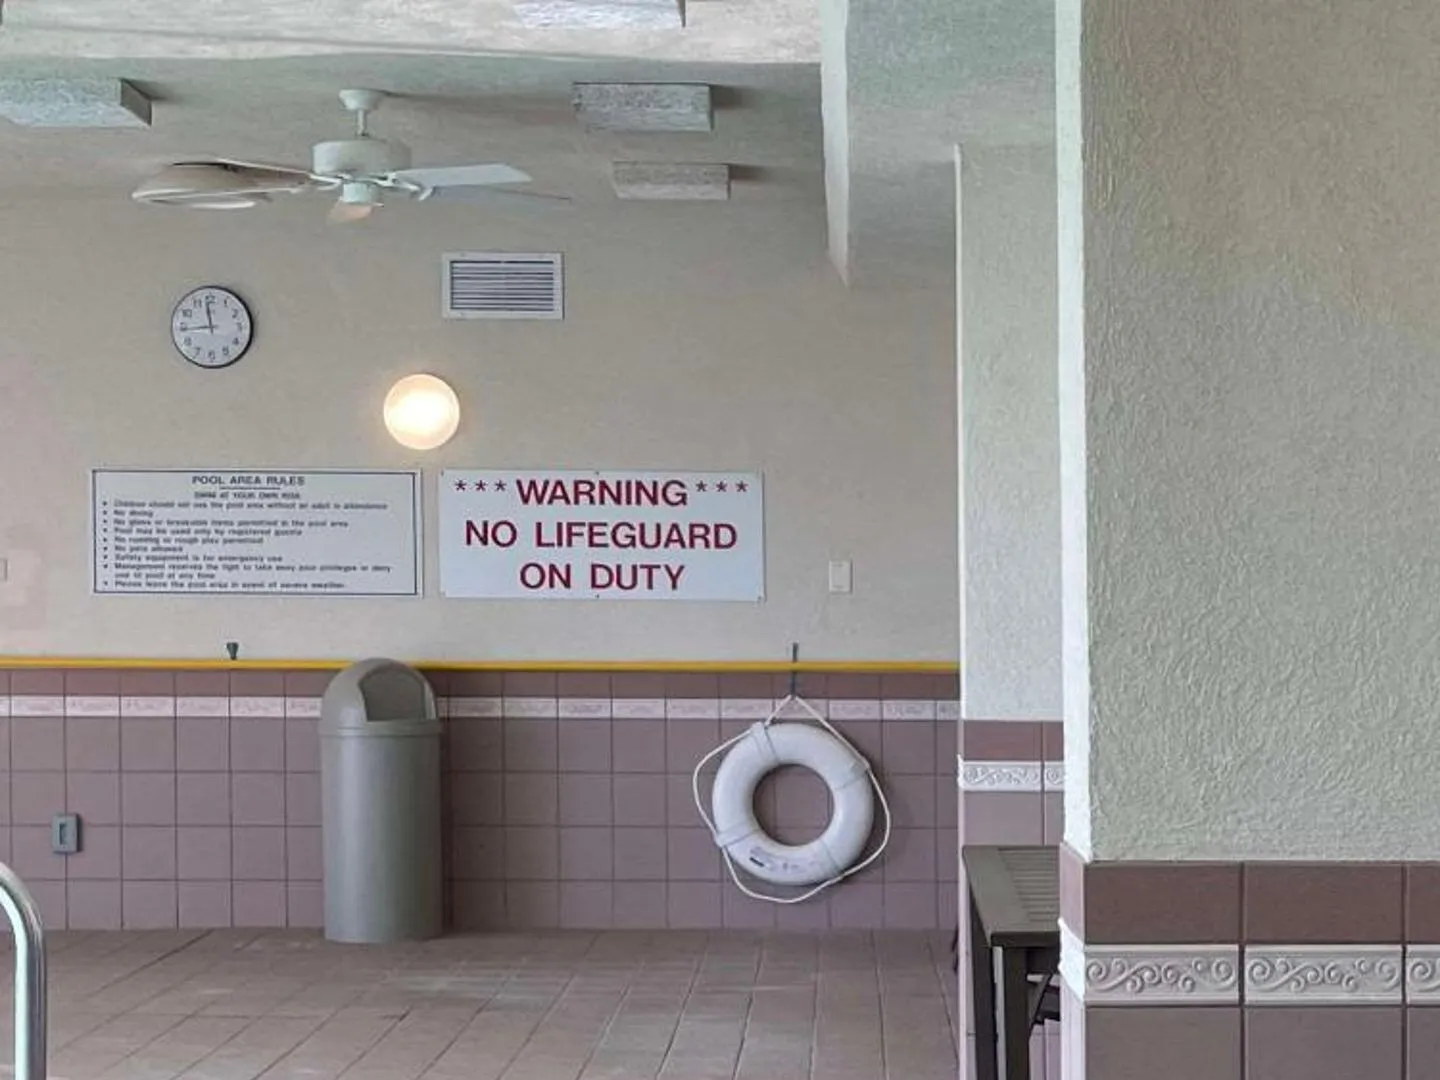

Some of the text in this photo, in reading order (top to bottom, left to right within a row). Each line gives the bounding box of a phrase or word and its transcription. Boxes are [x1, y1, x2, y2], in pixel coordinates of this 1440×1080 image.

[192, 475, 305, 486] POOL AREA RULES
[516, 479, 688, 507] WARNING
[465, 520, 738, 550] NO LIFEGUARD
[519, 562, 686, 591] ON DUTY
